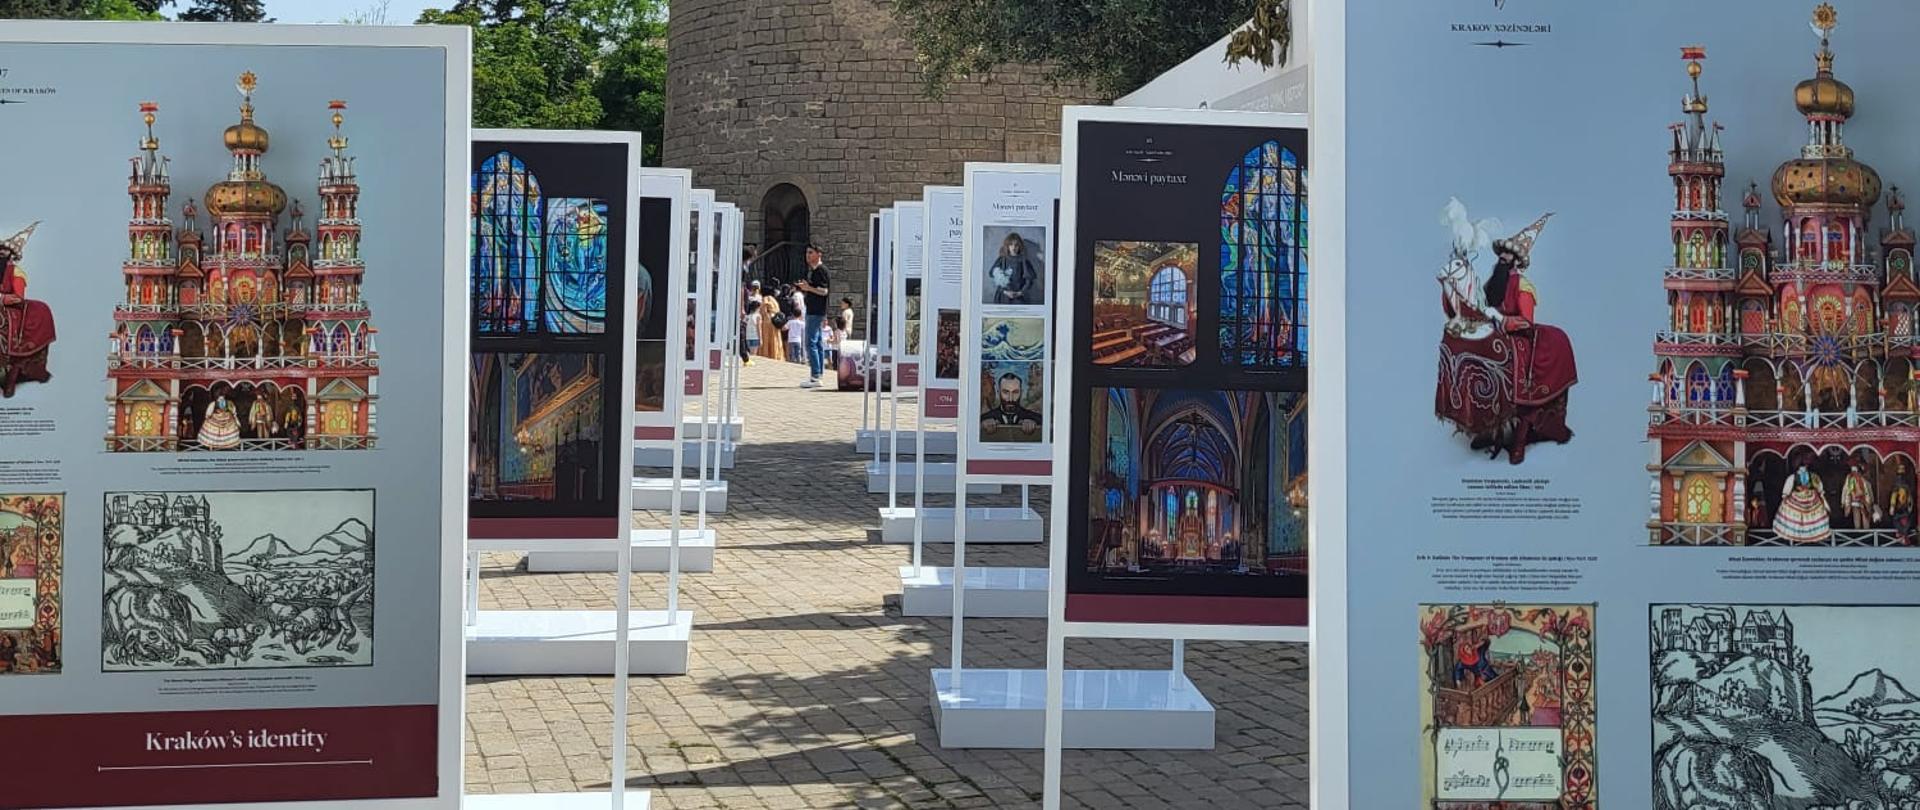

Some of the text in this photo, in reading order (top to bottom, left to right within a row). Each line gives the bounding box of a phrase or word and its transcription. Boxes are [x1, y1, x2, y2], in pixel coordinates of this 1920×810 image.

[1451, 23, 1490, 32] KRAKOV
[145, 728, 328, 752] Kraków’s identity
